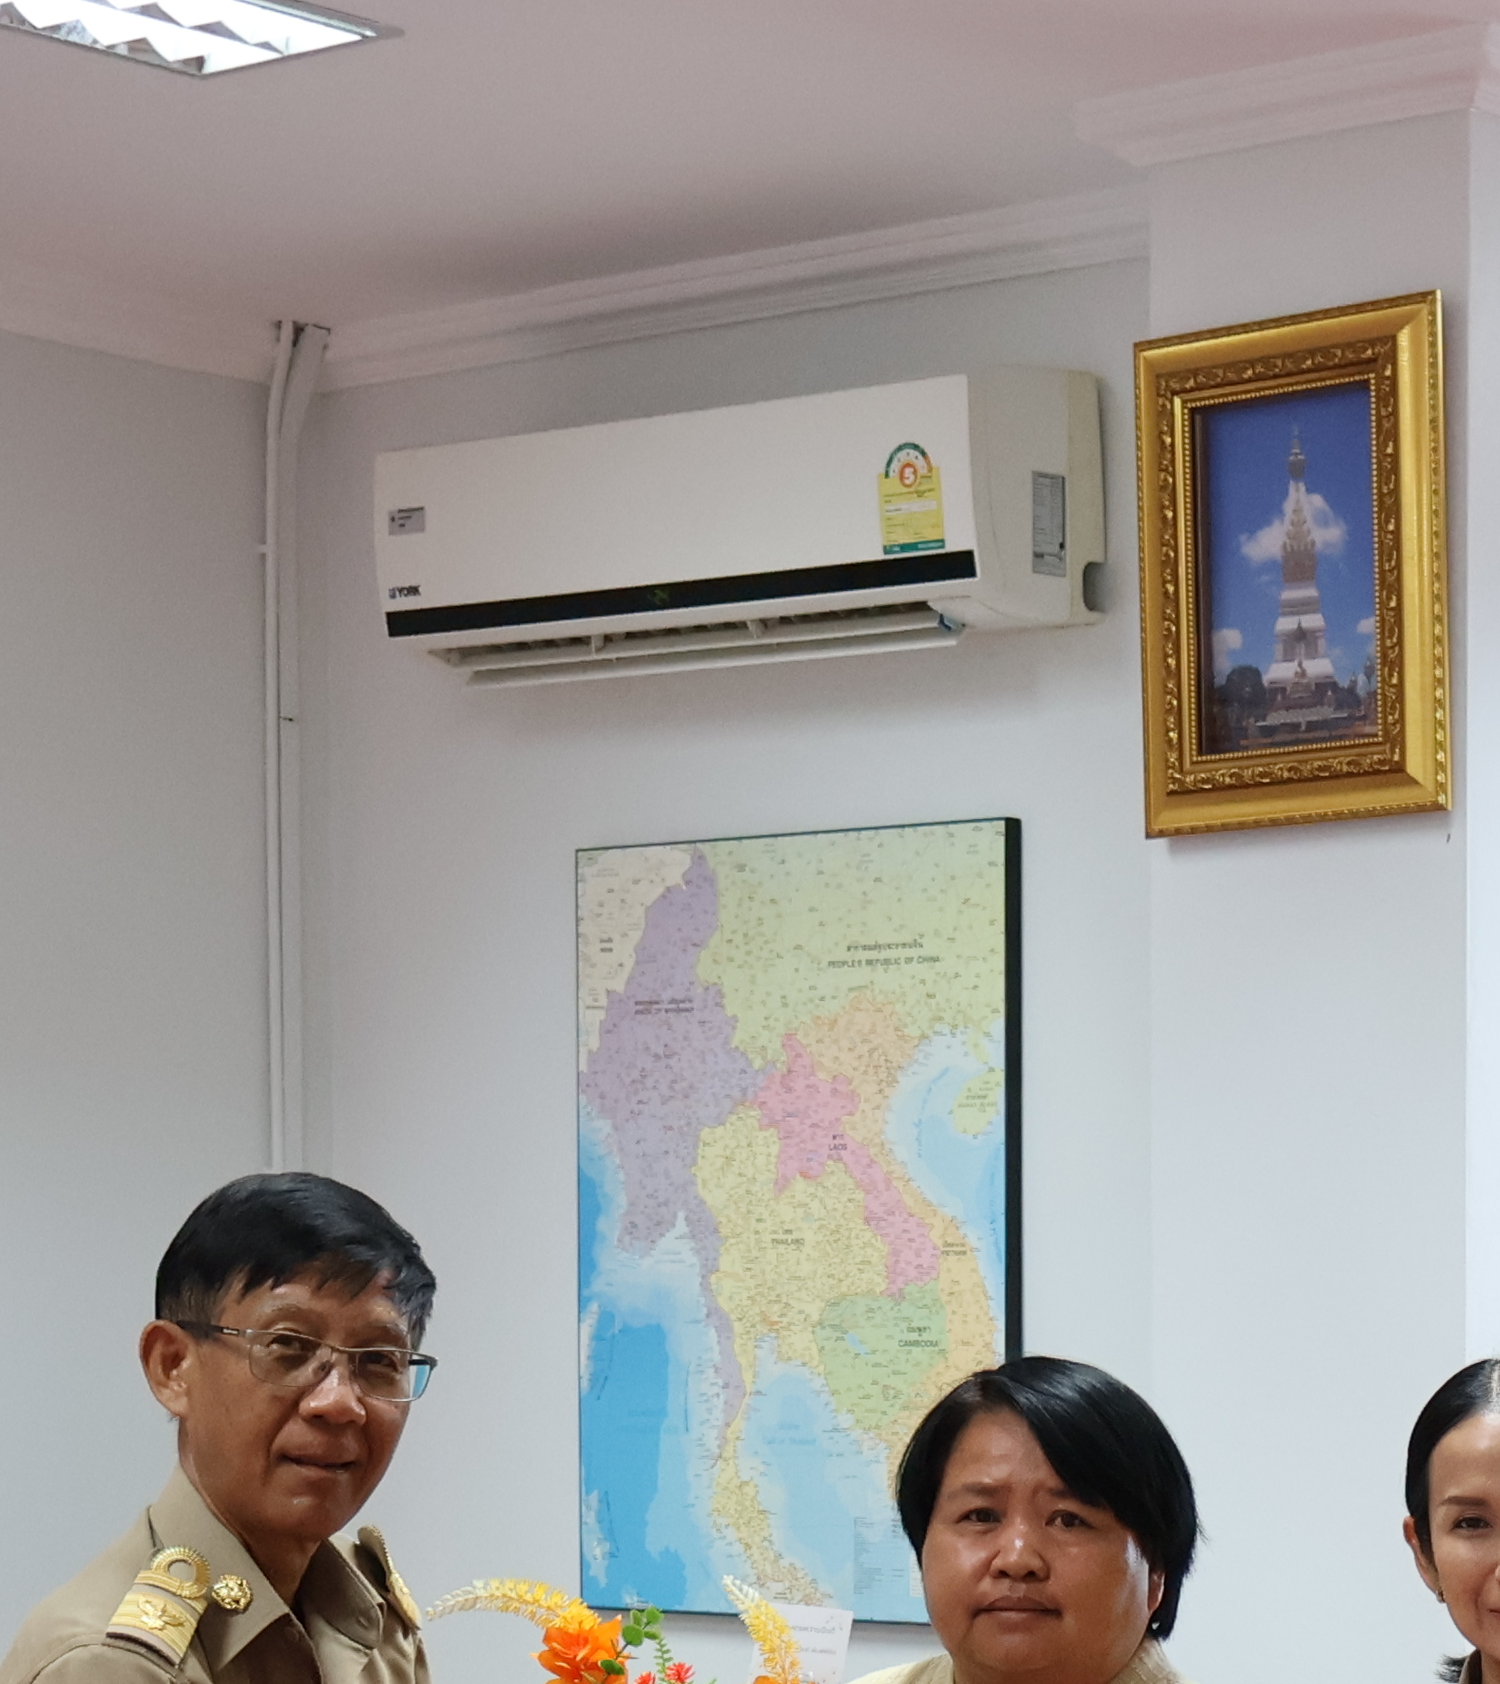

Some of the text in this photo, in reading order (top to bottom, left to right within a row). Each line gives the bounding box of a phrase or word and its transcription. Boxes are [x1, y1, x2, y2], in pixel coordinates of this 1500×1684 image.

[397, 585, 422, 598] YORK
[865, 957, 901, 968] REPUBLIC
[904, 957, 915, 965] OF
[917, 955, 940, 965] CHINA
[828, 1143, 848, 1151] LAOS
[898, 1339, 939, 1348] CAMBODIA
